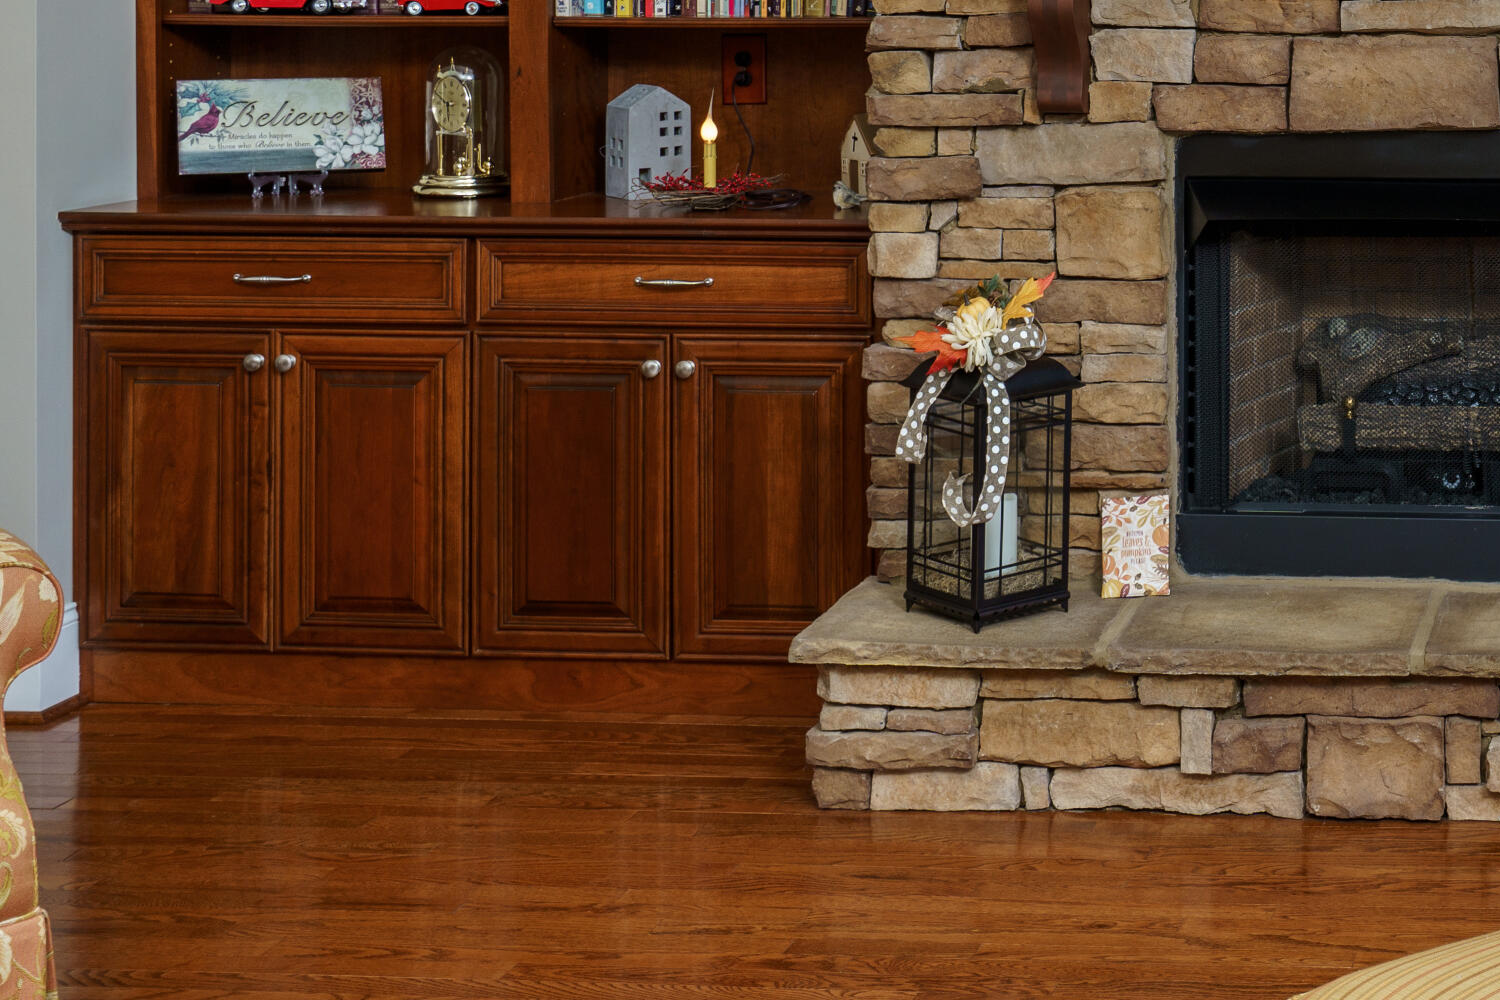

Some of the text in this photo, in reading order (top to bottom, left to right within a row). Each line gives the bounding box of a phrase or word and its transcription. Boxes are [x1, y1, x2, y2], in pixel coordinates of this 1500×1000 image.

[221, 100, 351, 128] Believe
[228, 132, 257, 140] Miracles
[269, 131, 293, 141] happen
[255, 141, 285, 149] Believe
